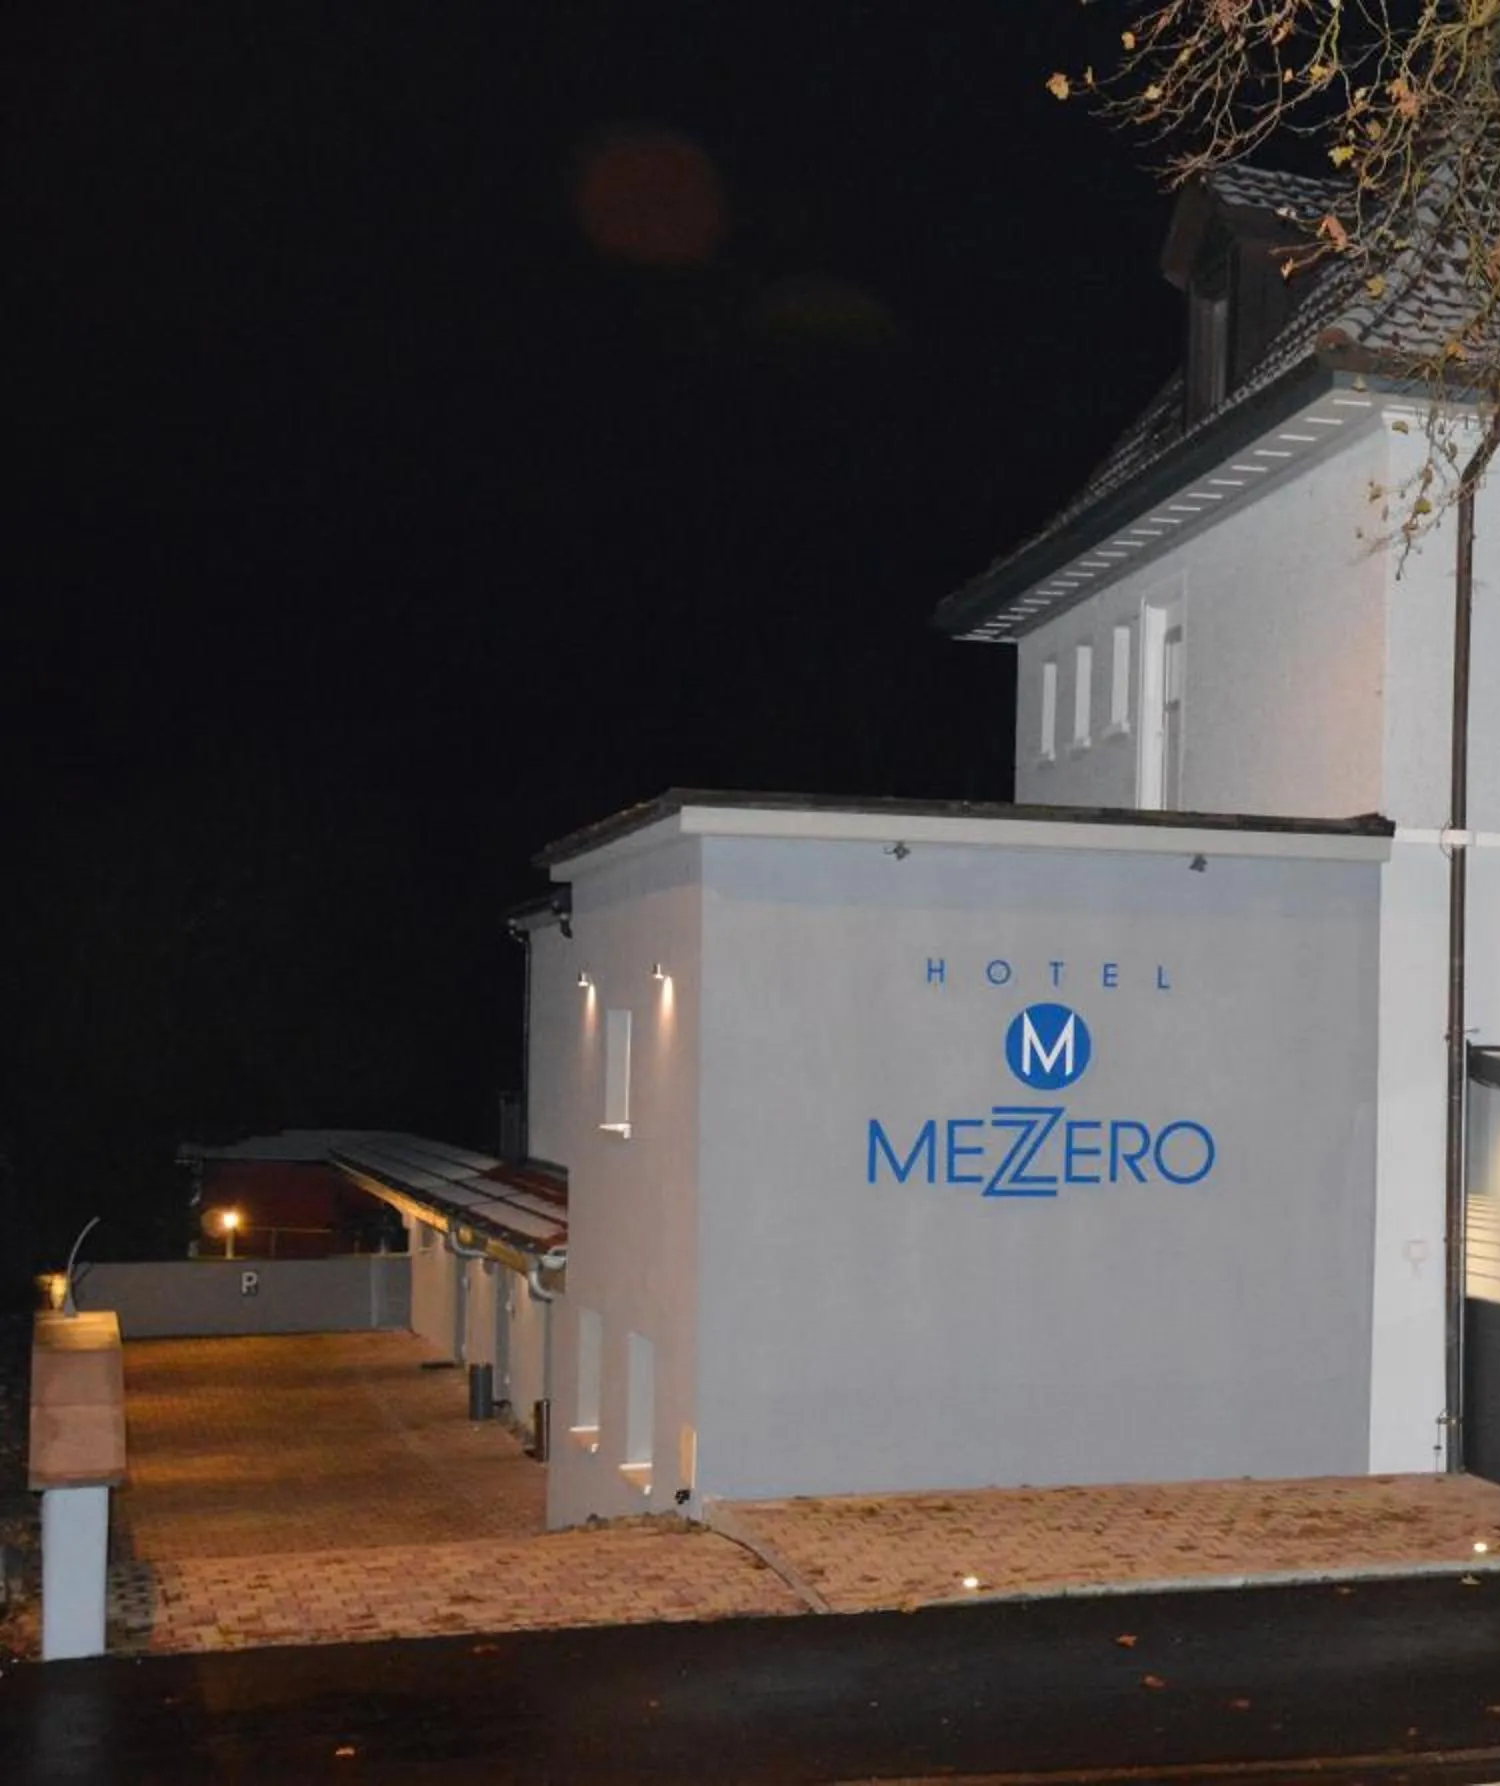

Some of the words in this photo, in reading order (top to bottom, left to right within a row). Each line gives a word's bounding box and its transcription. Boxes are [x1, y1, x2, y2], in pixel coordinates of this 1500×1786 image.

[926, 958, 1171, 990] HOTEL
[1022, 1010, 1075, 1076] M
[866, 1106, 1216, 1197] MEZZERO
